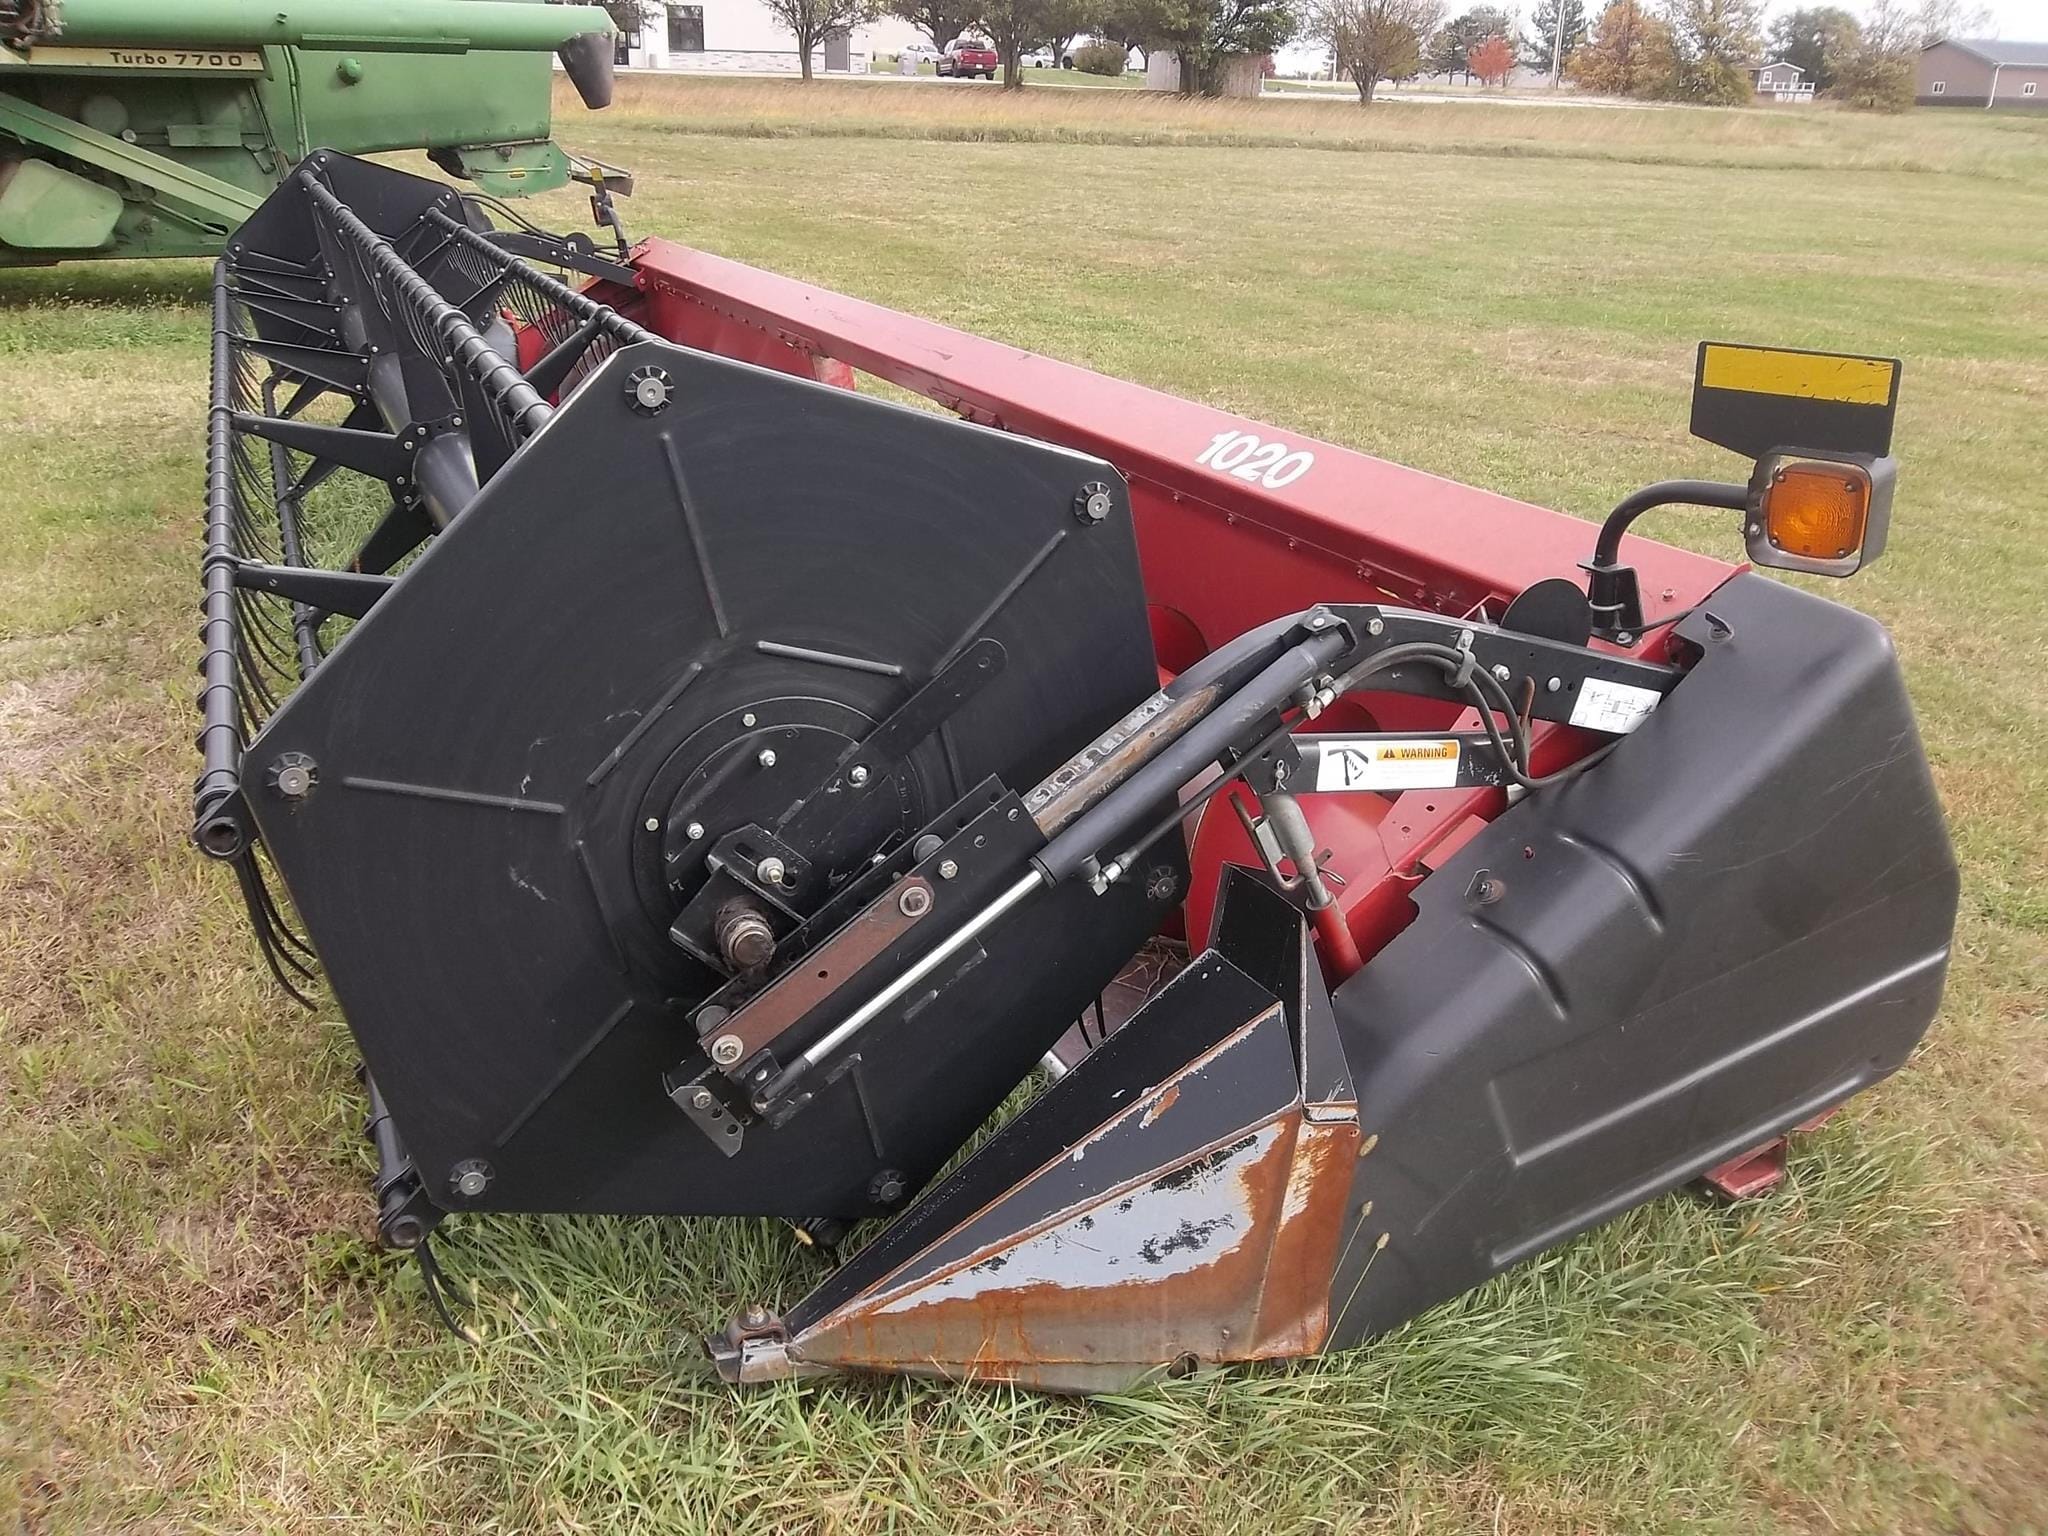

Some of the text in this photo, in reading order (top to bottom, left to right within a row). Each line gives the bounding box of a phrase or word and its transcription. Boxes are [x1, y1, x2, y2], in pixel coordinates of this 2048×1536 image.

[110, 52, 243, 66] Turbo 7700
[1195, 430, 1315, 489] 1020
[1400, 747, 1448, 759] WARNING
